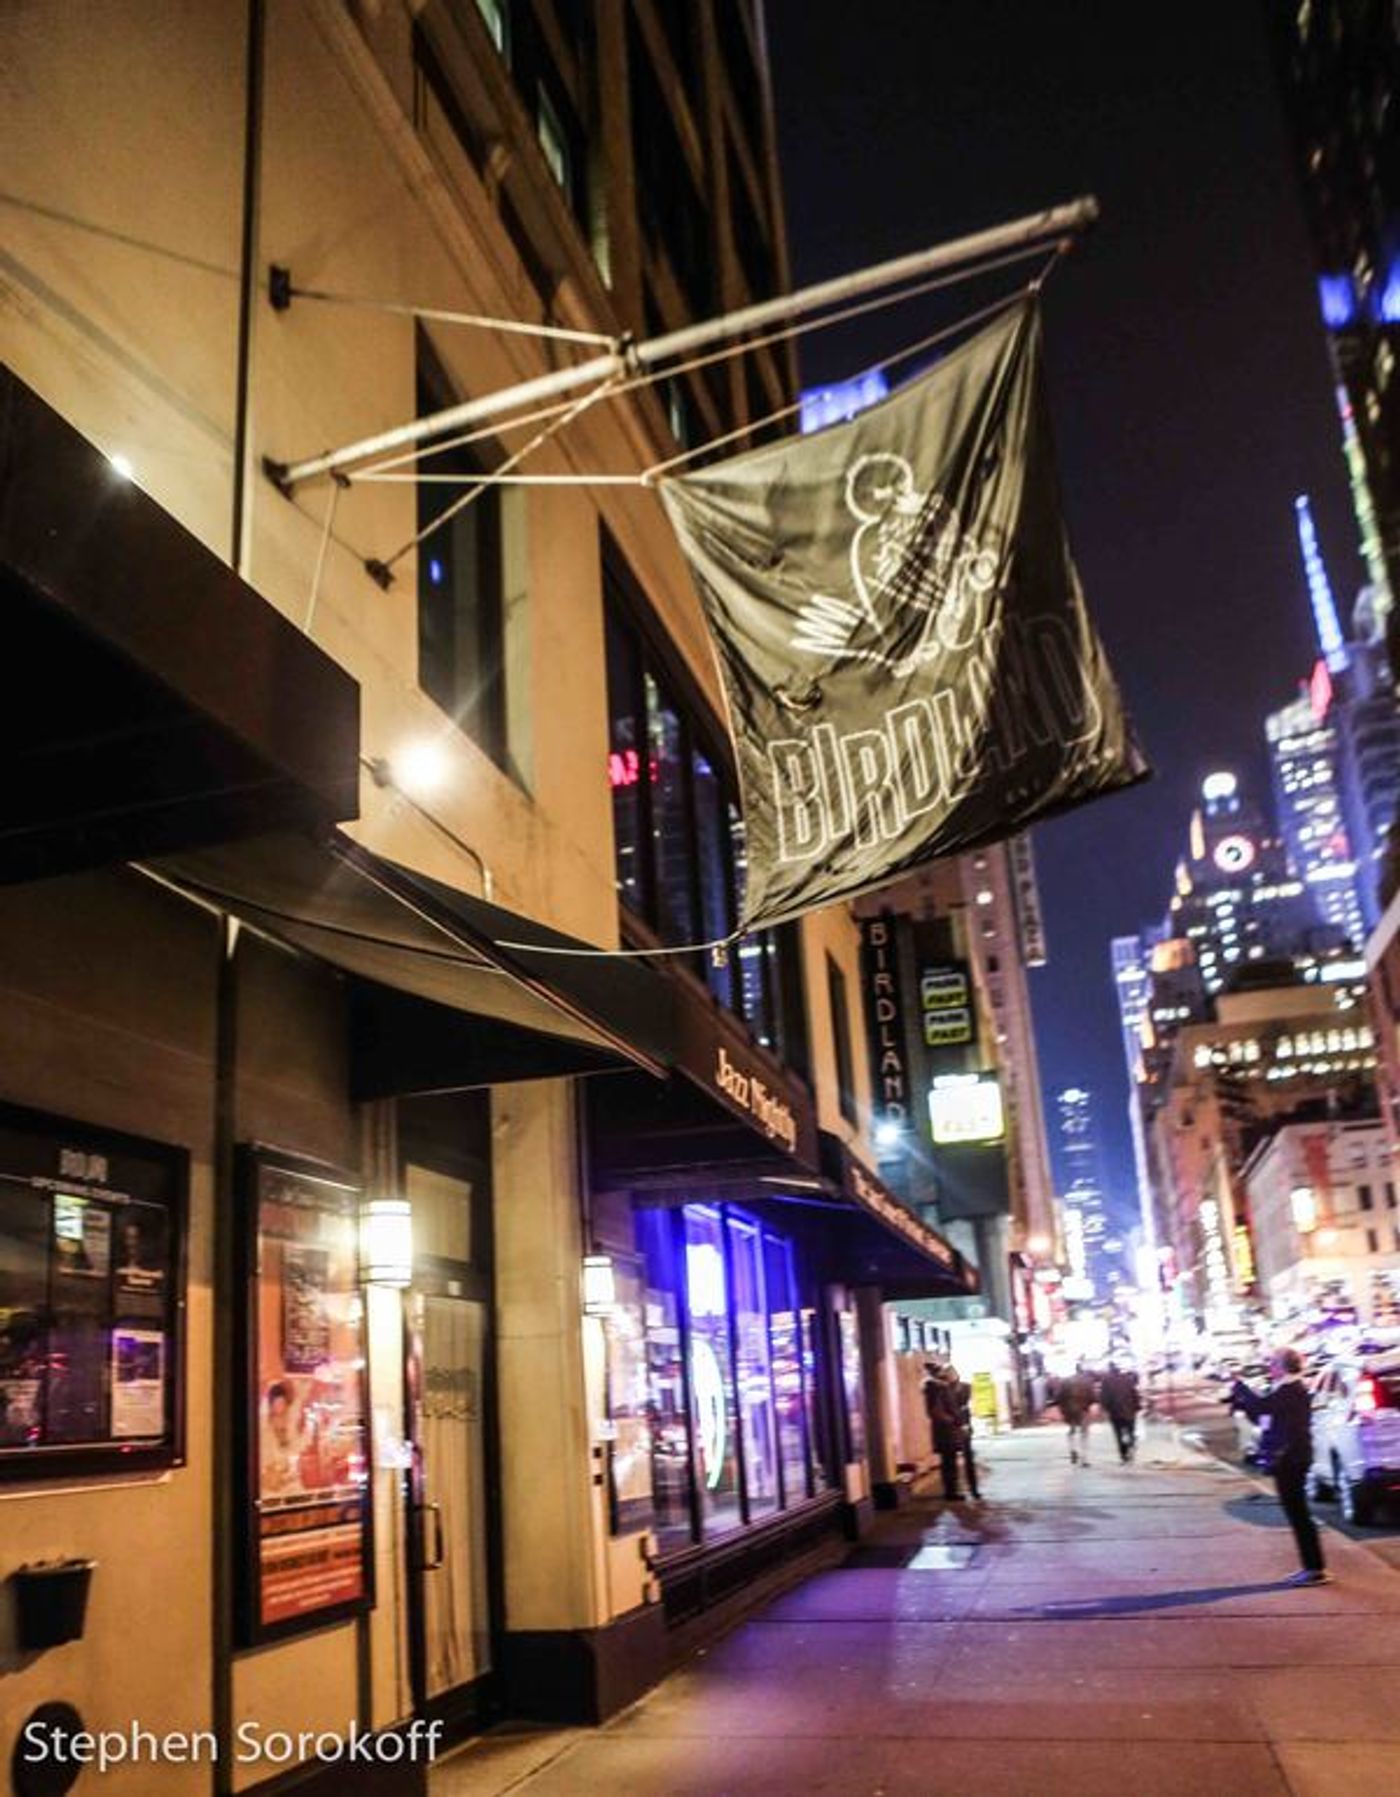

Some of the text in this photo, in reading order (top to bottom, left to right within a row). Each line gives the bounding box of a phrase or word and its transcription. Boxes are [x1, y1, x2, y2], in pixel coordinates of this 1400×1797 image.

[767, 613, 1102, 863] BIRDLAND
[716, 1046, 750, 1108] Jazz
[870, 922, 906, 1122] BIRDLAND
